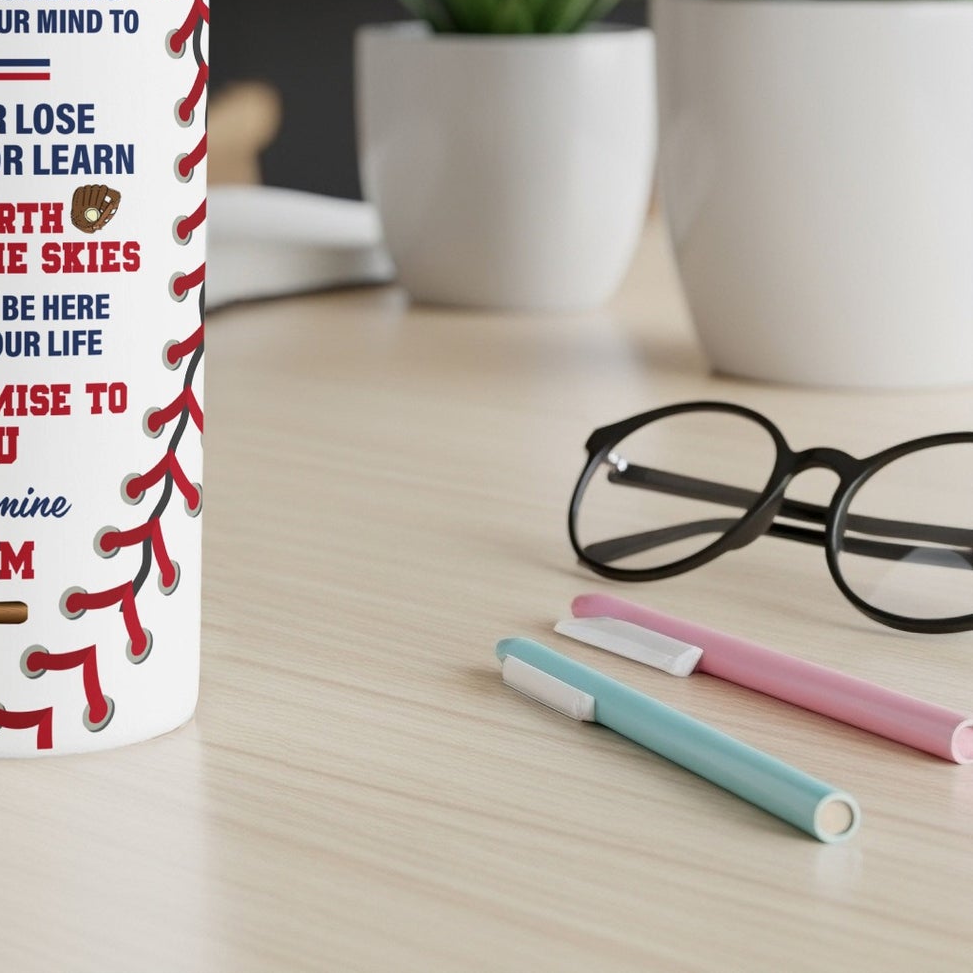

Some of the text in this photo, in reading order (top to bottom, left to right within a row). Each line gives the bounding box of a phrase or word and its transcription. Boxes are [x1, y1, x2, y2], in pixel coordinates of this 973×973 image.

[38, 10, 102, 33] MIND
[110, 10, 138, 33] TO
[17, 104, 94, 134] LOSE
[34, 145, 133, 174] LEARN
[41, 241, 141, 274] SKIES
[3, 296, 35, 320] BE
[44, 295, 109, 320] HERE
[49, 330, 101, 356] LIFE
[85, 382, 128, 415] TO
